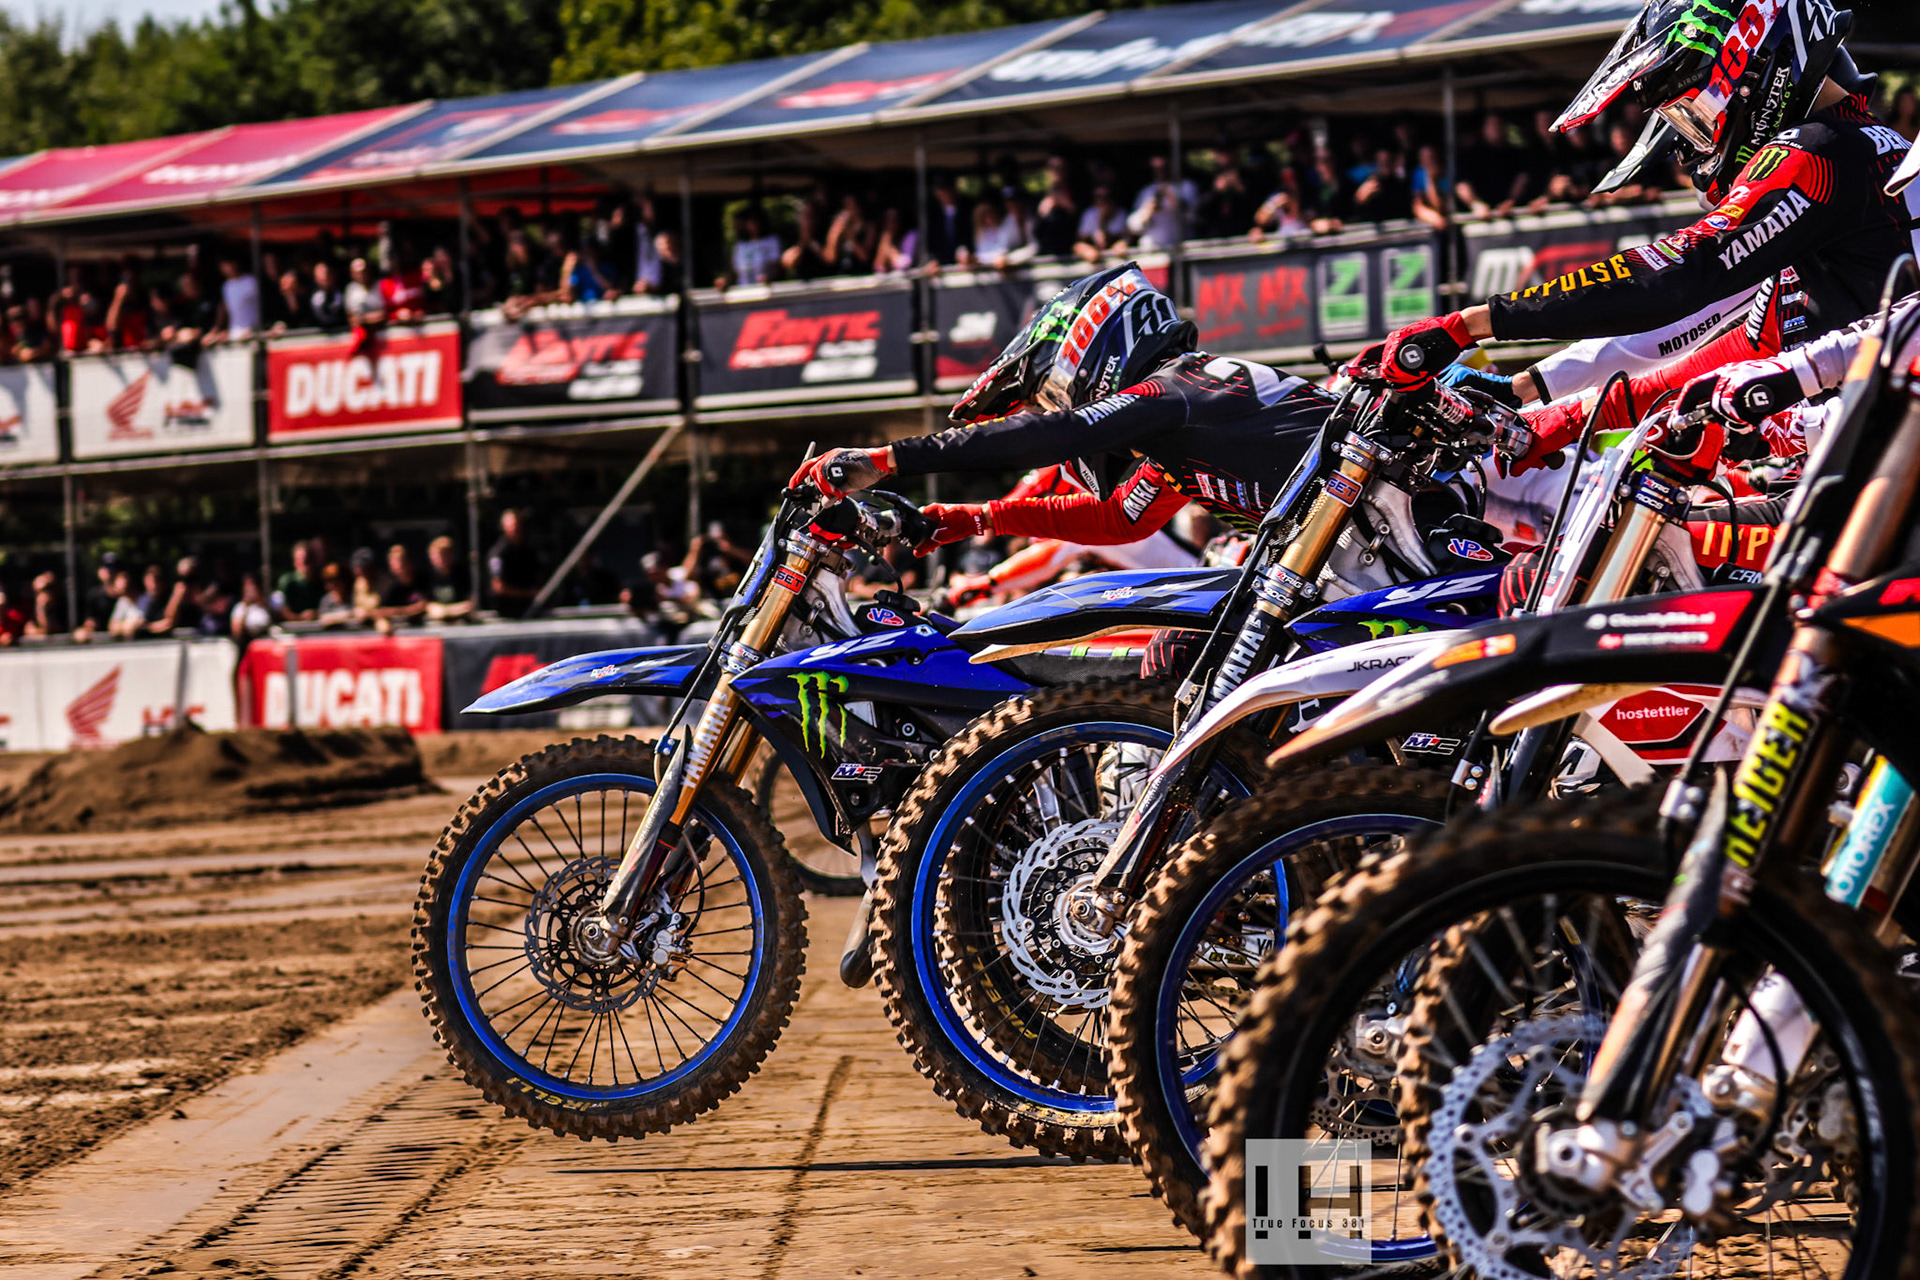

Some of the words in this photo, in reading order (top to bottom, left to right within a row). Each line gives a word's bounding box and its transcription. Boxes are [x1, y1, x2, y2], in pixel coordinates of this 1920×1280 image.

[1709, 0, 1780, 99] 100
[1718, 188, 1811, 271] YAMAHA
[1062, 278, 1137, 368] 100%
[1658, 313, 1722, 356] MOTOSED
[285, 350, 441, 418] DUCATI
[1094, 355, 1121, 402] NSTER
[1082, 470, 1099, 493] AIROH
[776, 570, 803, 588] SET
[264, 668, 423, 728] DUCATI
[1204, 630, 1266, 711] MAHA
[680, 702, 732, 789] YAMAHA
[1616, 706, 1691, 720] hostettler
[1827, 798, 1895, 903] OTOREX
